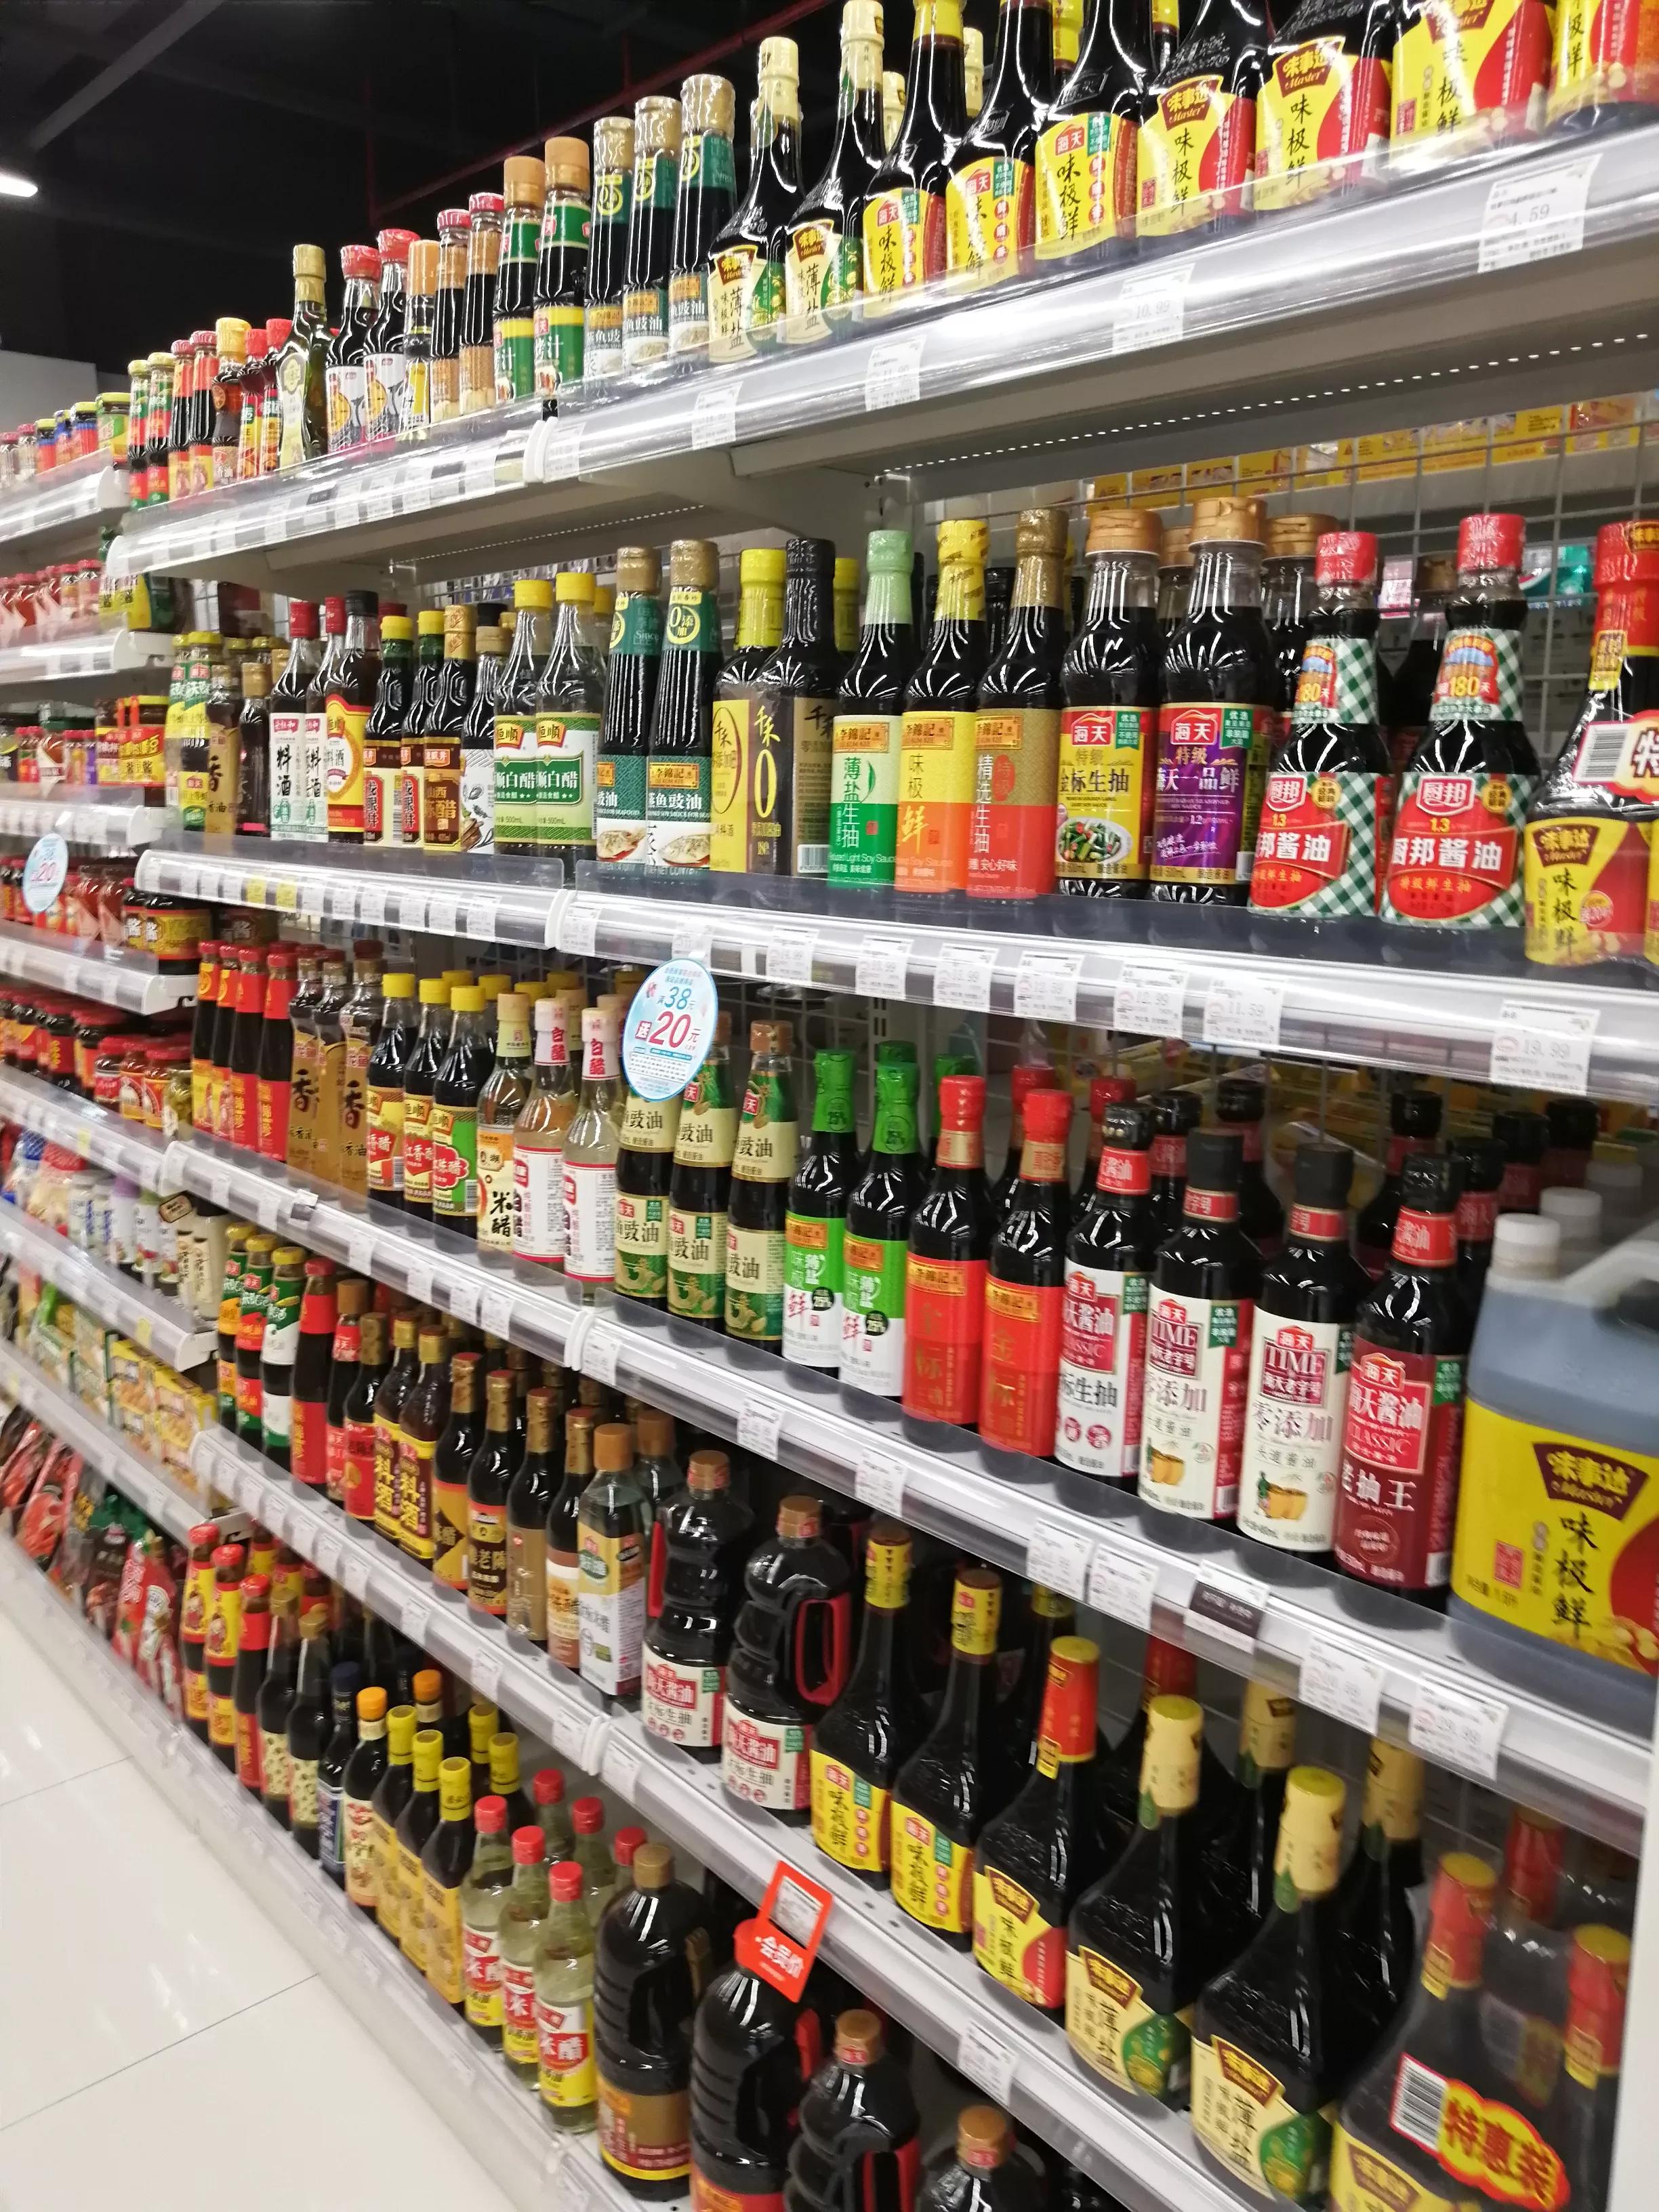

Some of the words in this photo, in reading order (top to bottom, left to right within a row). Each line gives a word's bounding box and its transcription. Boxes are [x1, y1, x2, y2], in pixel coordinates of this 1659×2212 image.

[1285, 68, 1325, 89] Master
[1168, 104, 1205, 123] Master
[1057, 130, 1085, 155] 海天
[1286, 94, 1313, 188] 味极鲜
[1170, 127, 1194, 216] 味极鲜
[1057, 153, 1082, 242] 味极鲜
[878, 224, 897, 302] 味极鲜
[805, 262, 821, 331] 薄盐
[730, 287, 744, 351] 薄盐
[754, 705, 781, 747] 千禾
[1073, 724, 1108, 743] 海天
[1174, 722, 1212, 741] 海天
[276, 743, 293, 797] 料酒
[1075, 747, 1105, 766] 特级
[1176, 746, 1208, 765] 特级
[754, 748, 777, 819] 0
[1058, 767, 1130, 794] 金标生抽
[1271, 780, 1302, 802] 厨邦
[1422, 781, 1467, 806] 厨邦
[842, 756, 863, 850] 薄盐生抽
[901, 752, 929, 855] 味极鲜
[1272, 813, 1287, 827] 1.3
[1430, 817, 1450, 833] 1.3
[862, 853, 874, 865] Soy
[1551, 866, 1578, 956] 味极鲜
[552, 1026, 566, 1061] 白醋
[590, 1038, 605, 1075] 白醋
[293, 1068, 315, 1113] 香
[345, 1079, 367, 1130] 香
[489, 1190, 512, 1237] 米醋
[916, 1267, 949, 1284] 李錦記
[1068, 1279, 1094, 1300] 海天
[993, 1290, 1023, 1309] 李錦記
[1160, 1305, 1184, 1322] 海天
[1279, 1332, 1310, 1350] 海天
[1266, 1345, 1324, 1375] TIME
[1364, 1361, 1399, 1387] 海天
[1252, 1399, 1333, 1441] 零添加
[375, 1454, 395, 1517] 料酒
[1546, 1450, 1631, 1497] 味事达
[400, 1472, 420, 1534] 料酒
[1552, 1511, 1599, 1639] 味极鲜
[539, 2034, 583, 2061] 米醋
